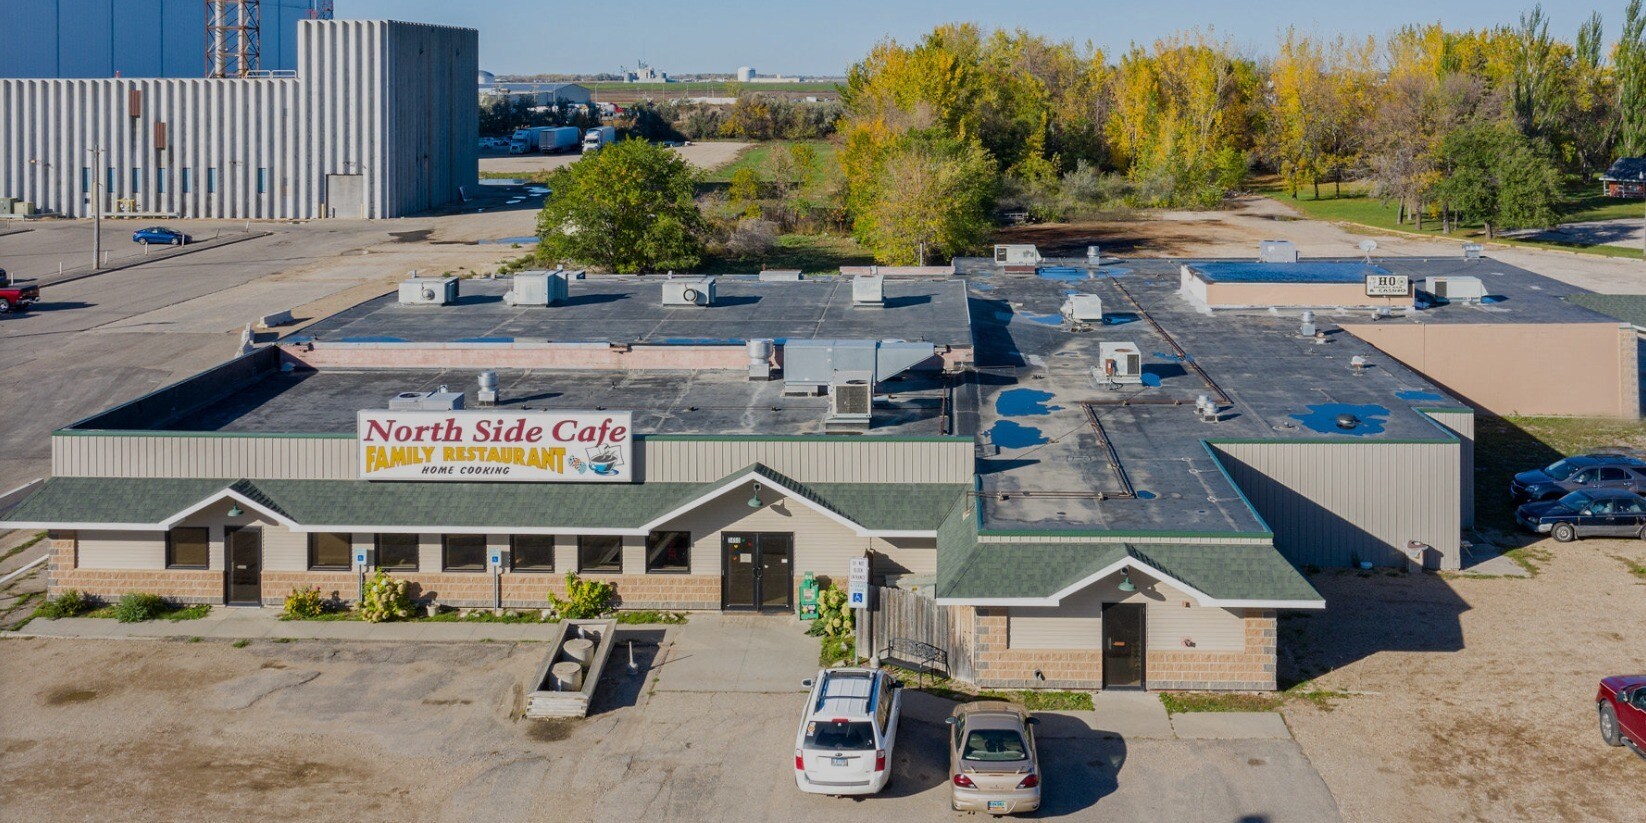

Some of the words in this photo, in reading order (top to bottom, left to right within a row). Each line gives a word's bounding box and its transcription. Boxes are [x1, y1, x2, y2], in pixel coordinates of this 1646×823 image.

[363, 418, 463, 442] North
[472, 418, 543, 443] Side
[552, 418, 627, 448] Cafe
[365, 445, 436, 474] FAMILY
[442, 446, 567, 475] RESTAURANT
[421, 466, 455, 475] HOME
[460, 466, 511, 475] COOKING
